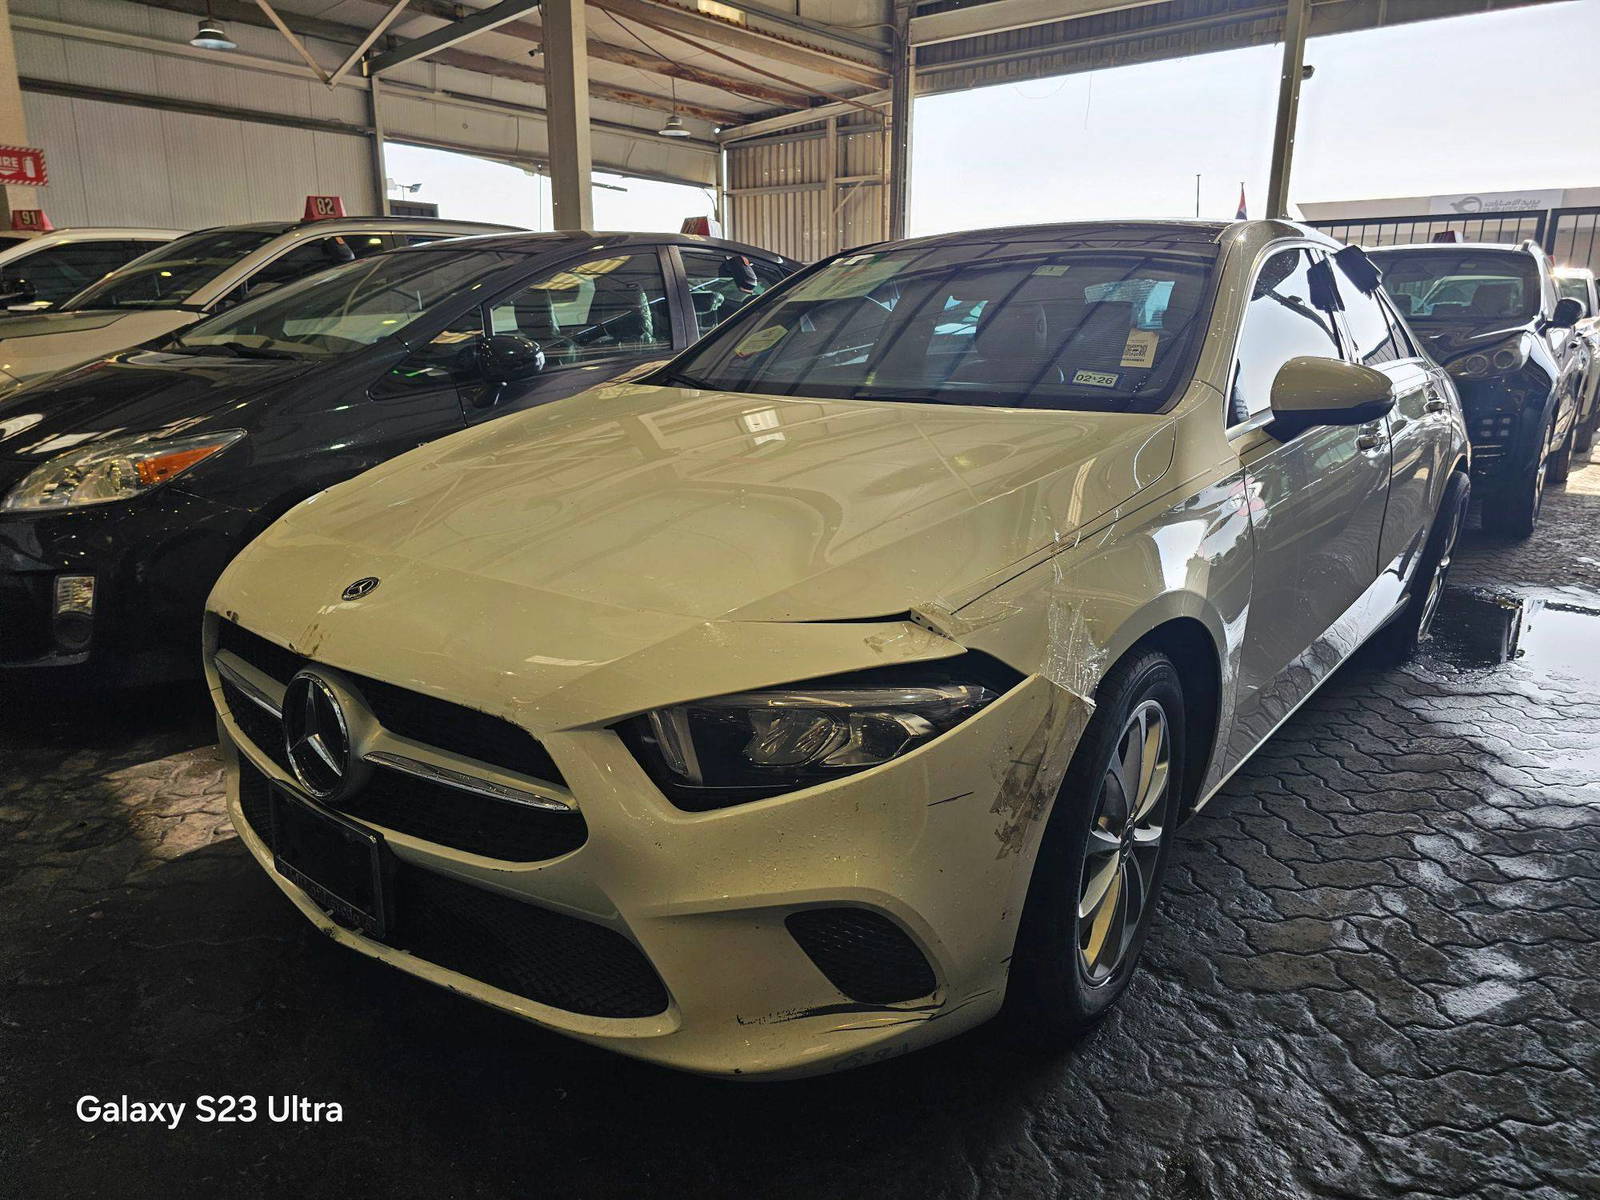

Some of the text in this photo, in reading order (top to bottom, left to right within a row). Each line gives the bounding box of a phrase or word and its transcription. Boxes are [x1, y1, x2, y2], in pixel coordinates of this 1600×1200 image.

[317, 198, 335, 215] 82
[22, 211, 37, 225] 91
[1076, 374, 1092, 383] 02
[1097, 376, 1114, 385] 26
